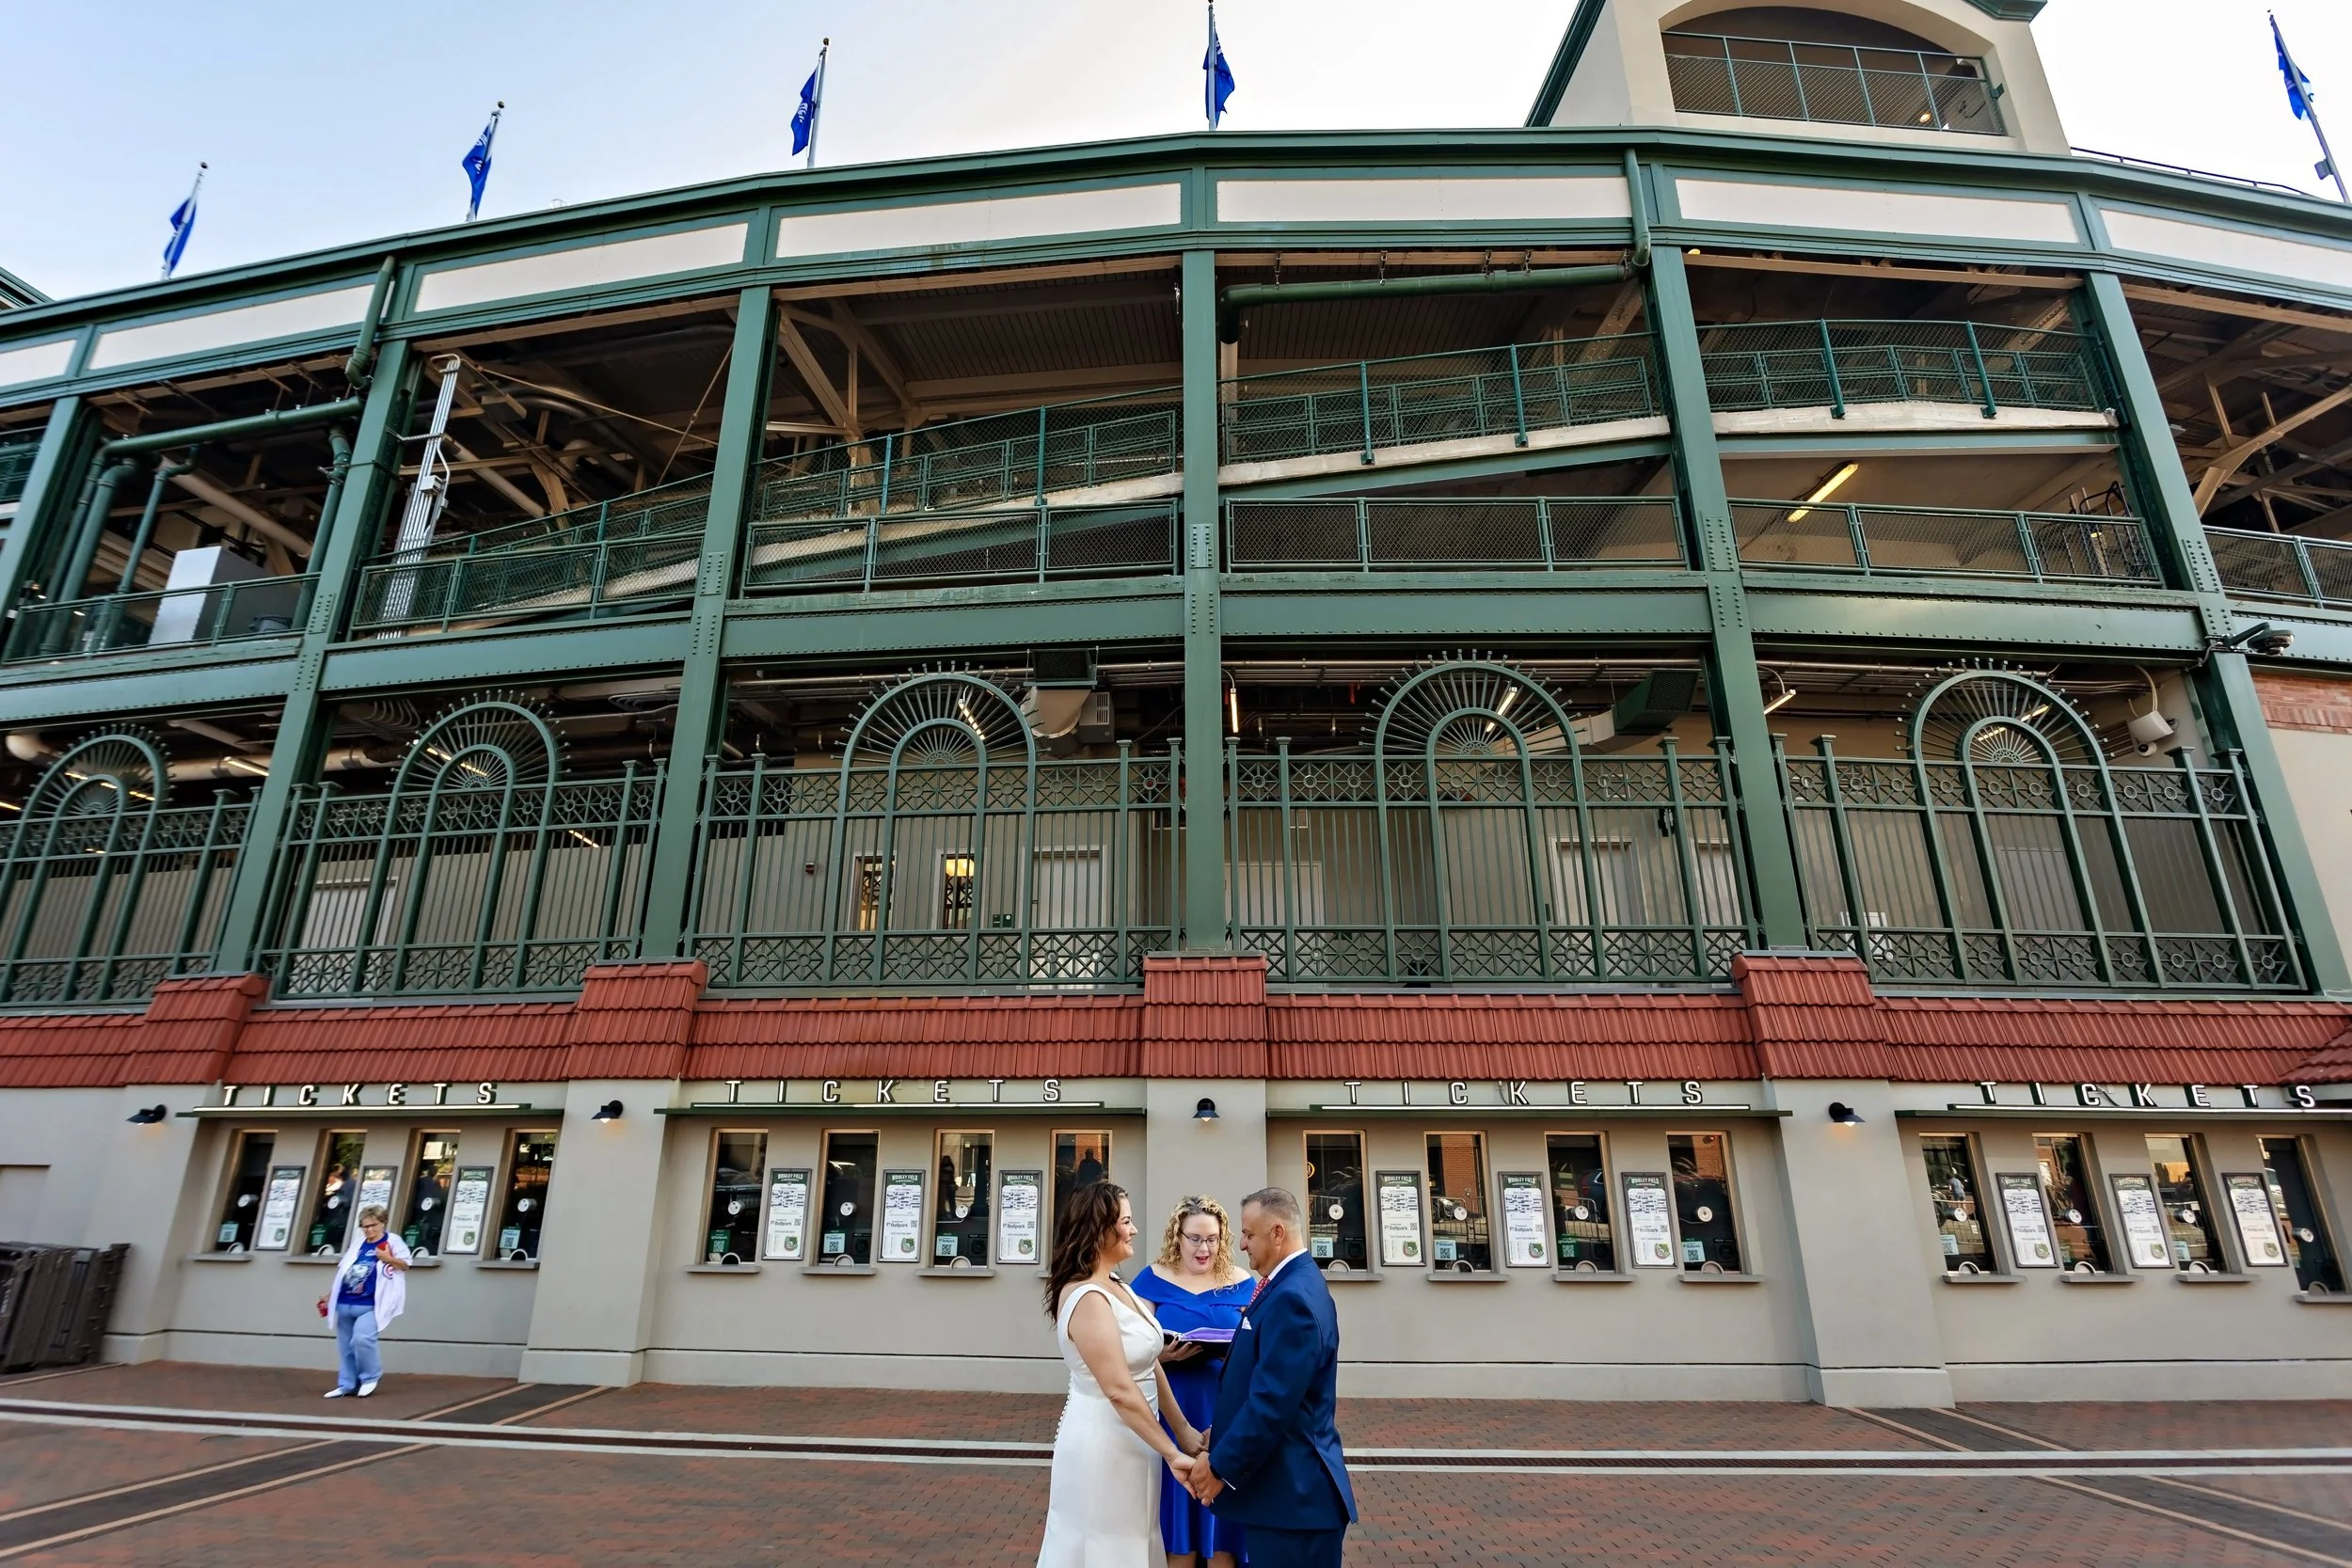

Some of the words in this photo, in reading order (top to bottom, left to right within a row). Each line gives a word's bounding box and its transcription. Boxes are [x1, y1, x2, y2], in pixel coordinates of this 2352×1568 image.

[222, 1082, 498, 1106] TICKETS
[725, 1079, 1062, 1103] TICKETS
[1343, 1080, 1704, 1105] TICKETS
[1977, 1082, 2315, 1108] TICKETS
